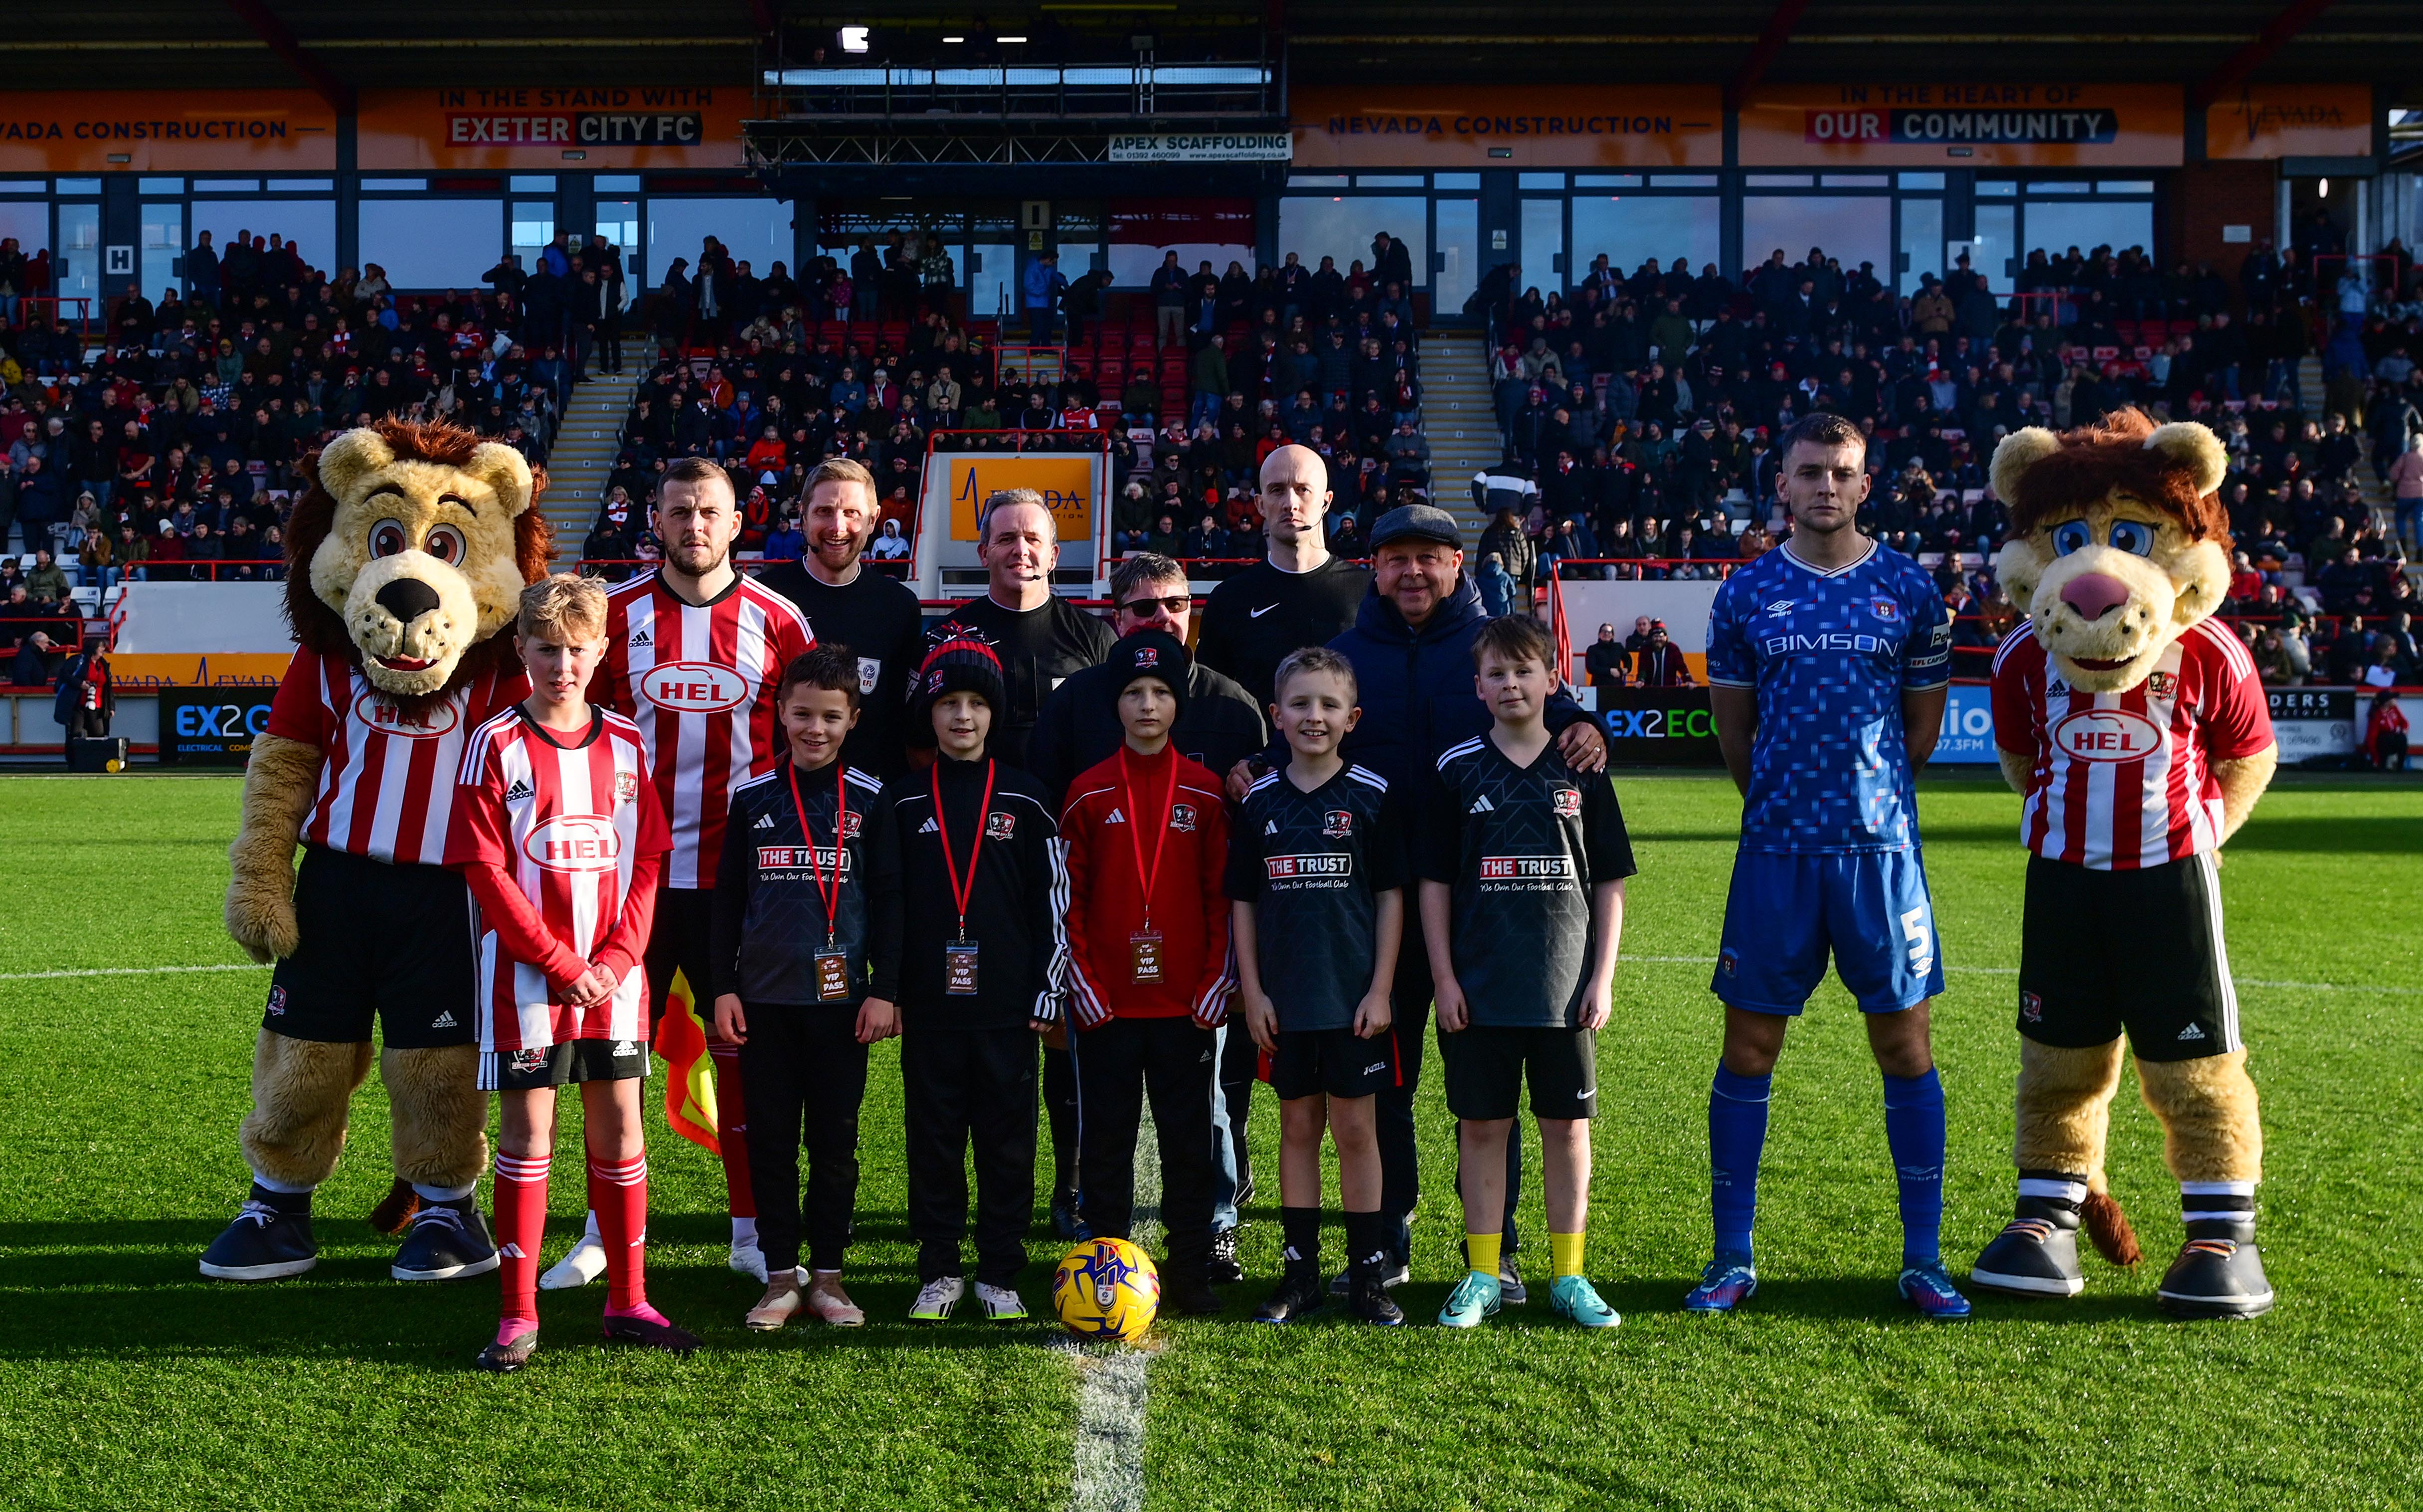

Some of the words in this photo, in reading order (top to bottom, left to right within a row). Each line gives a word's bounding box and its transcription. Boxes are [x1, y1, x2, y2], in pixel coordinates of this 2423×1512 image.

[440, 91, 465, 107] IN
[477, 91, 527, 107] THE
[540, 89, 630, 106] STAND
[642, 88, 712, 106] WITH
[1841, 87, 1867, 103] IN
[1881, 87, 1931, 103] THE
[1944, 87, 2035, 103] HEART
[2046, 87, 2082, 103] OF
[74, 121, 287, 139] CONSTRUCTION
[451, 118, 570, 143] EXETER
[580, 117, 647, 142] CITY
[657, 116, 695, 141] FC
[1329, 116, 1444, 134] NEVADA
[1454, 116, 1673, 134] CONSTRUCTION
[1814, 114, 1881, 139] OUR
[1903, 113, 2102, 139] COMMUNITY
[1112, 137, 1159, 150] APEX
[1167, 136, 1287, 150] SCAFFOLDING
[112, 250, 129, 269] H
[1768, 609, 1792, 619] umbro
[1765, 633, 1899, 658] BIMSON
[190, 656, 279, 687] NEVAD
[111, 675, 175, 687] VADA
[660, 681, 729, 702] HEL
[2269, 693, 2330, 708] DERS
[1934, 739, 1984, 751] 07.3FM
[2073, 732, 2140, 751] HEL
[506, 791, 534, 802] adidas
[545, 840, 618, 860] HEL
[761, 850, 790, 865] THE
[795, 850, 848, 867] TRUST
[1269, 859, 1293, 875] THE
[1296, 857, 1347, 872] TRUST
[1481, 860, 1513, 876] THE
[1518, 860, 1570, 875] TRUST
[770, 872, 785, 881] Own
[786, 872, 799, 881] Our
[801, 872, 830, 882] Footall
[1292, 881, 1304, 889] Our
[1305, 880, 1333, 889] Football
[1333, 880, 1349, 889] Club
[1494, 882, 1510, 892] Own
[1511, 882, 1525, 891] Our
[1527, 882, 1555, 891] Football
[1556, 882, 1574, 891] Club
[1900, 905, 1930, 961] 5
[1140, 957, 1155, 965] VIP
[824, 972, 840, 982] VIP
[954, 968, 969, 976] VIP
[1137, 965, 1159, 974] PASS
[823, 981, 844, 992] PASS
[951, 976, 972, 985] PASS
